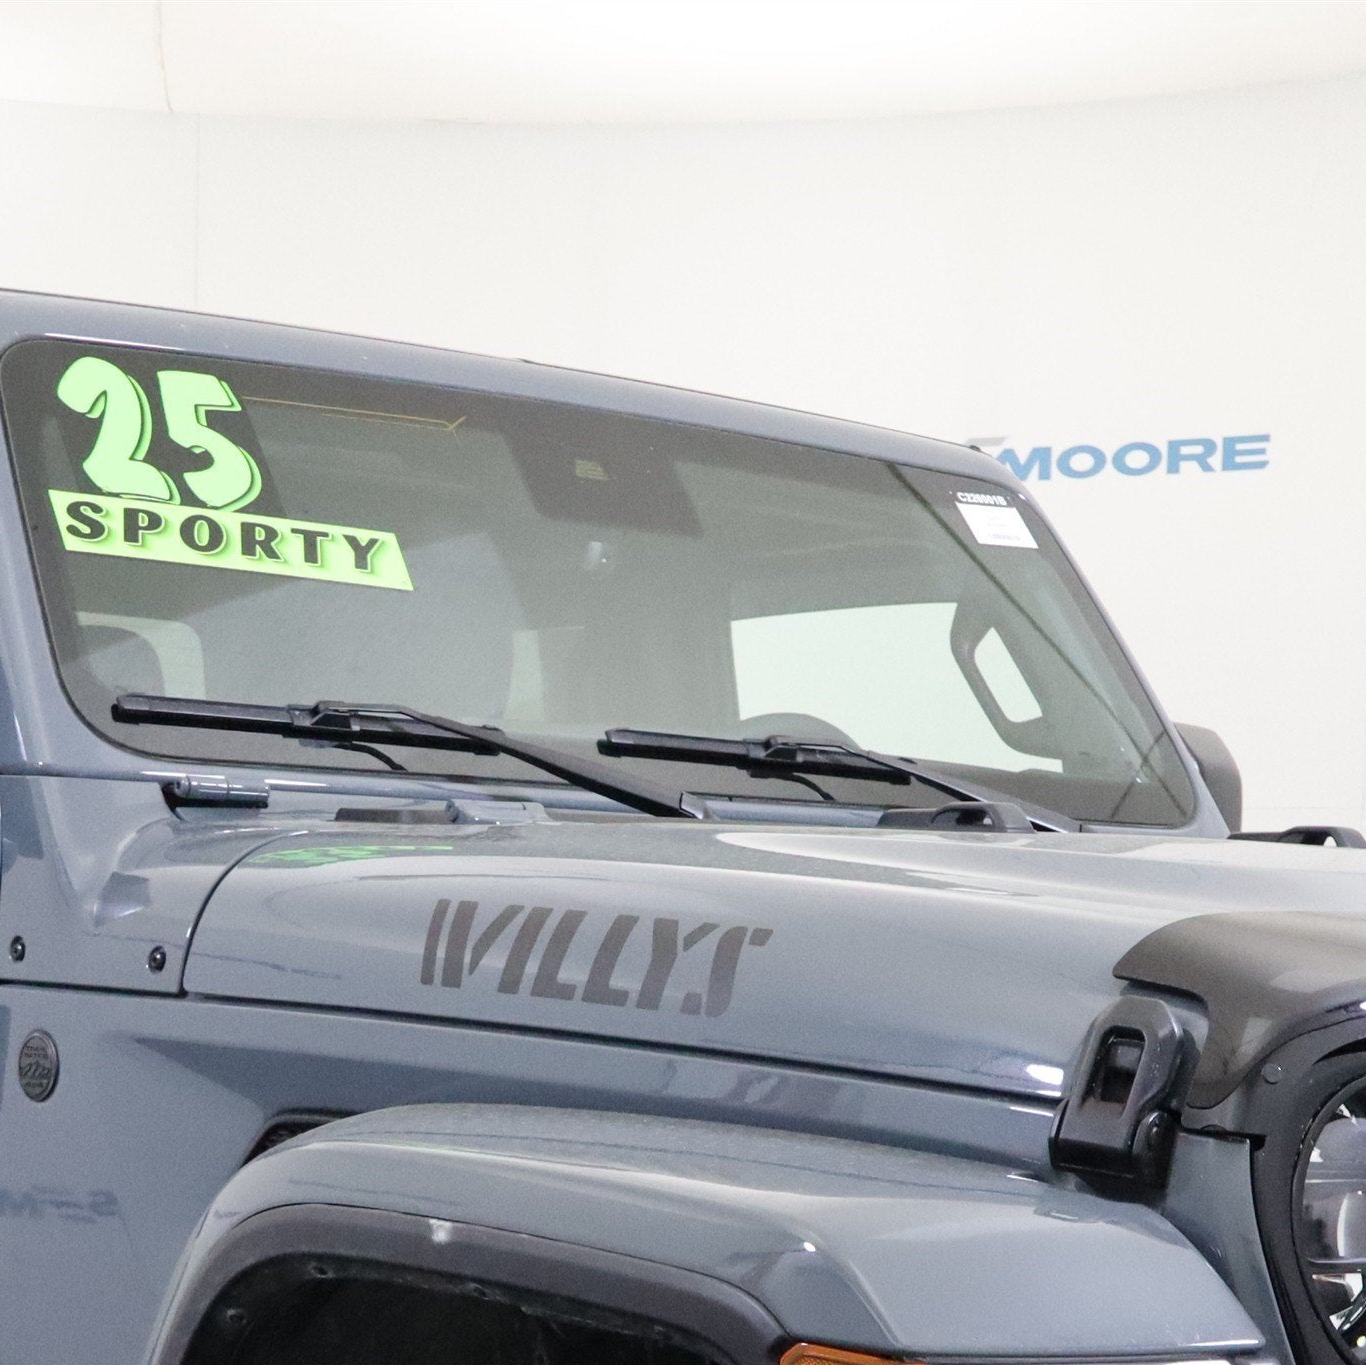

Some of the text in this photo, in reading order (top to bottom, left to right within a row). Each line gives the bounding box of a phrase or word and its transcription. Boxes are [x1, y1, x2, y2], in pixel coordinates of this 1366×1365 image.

[57, 356, 262, 511] 25
[999, 434, 1271, 481] MOORE
[65, 501, 381, 573] SPORTY
[420, 898, 774, 1018] WILLYS
